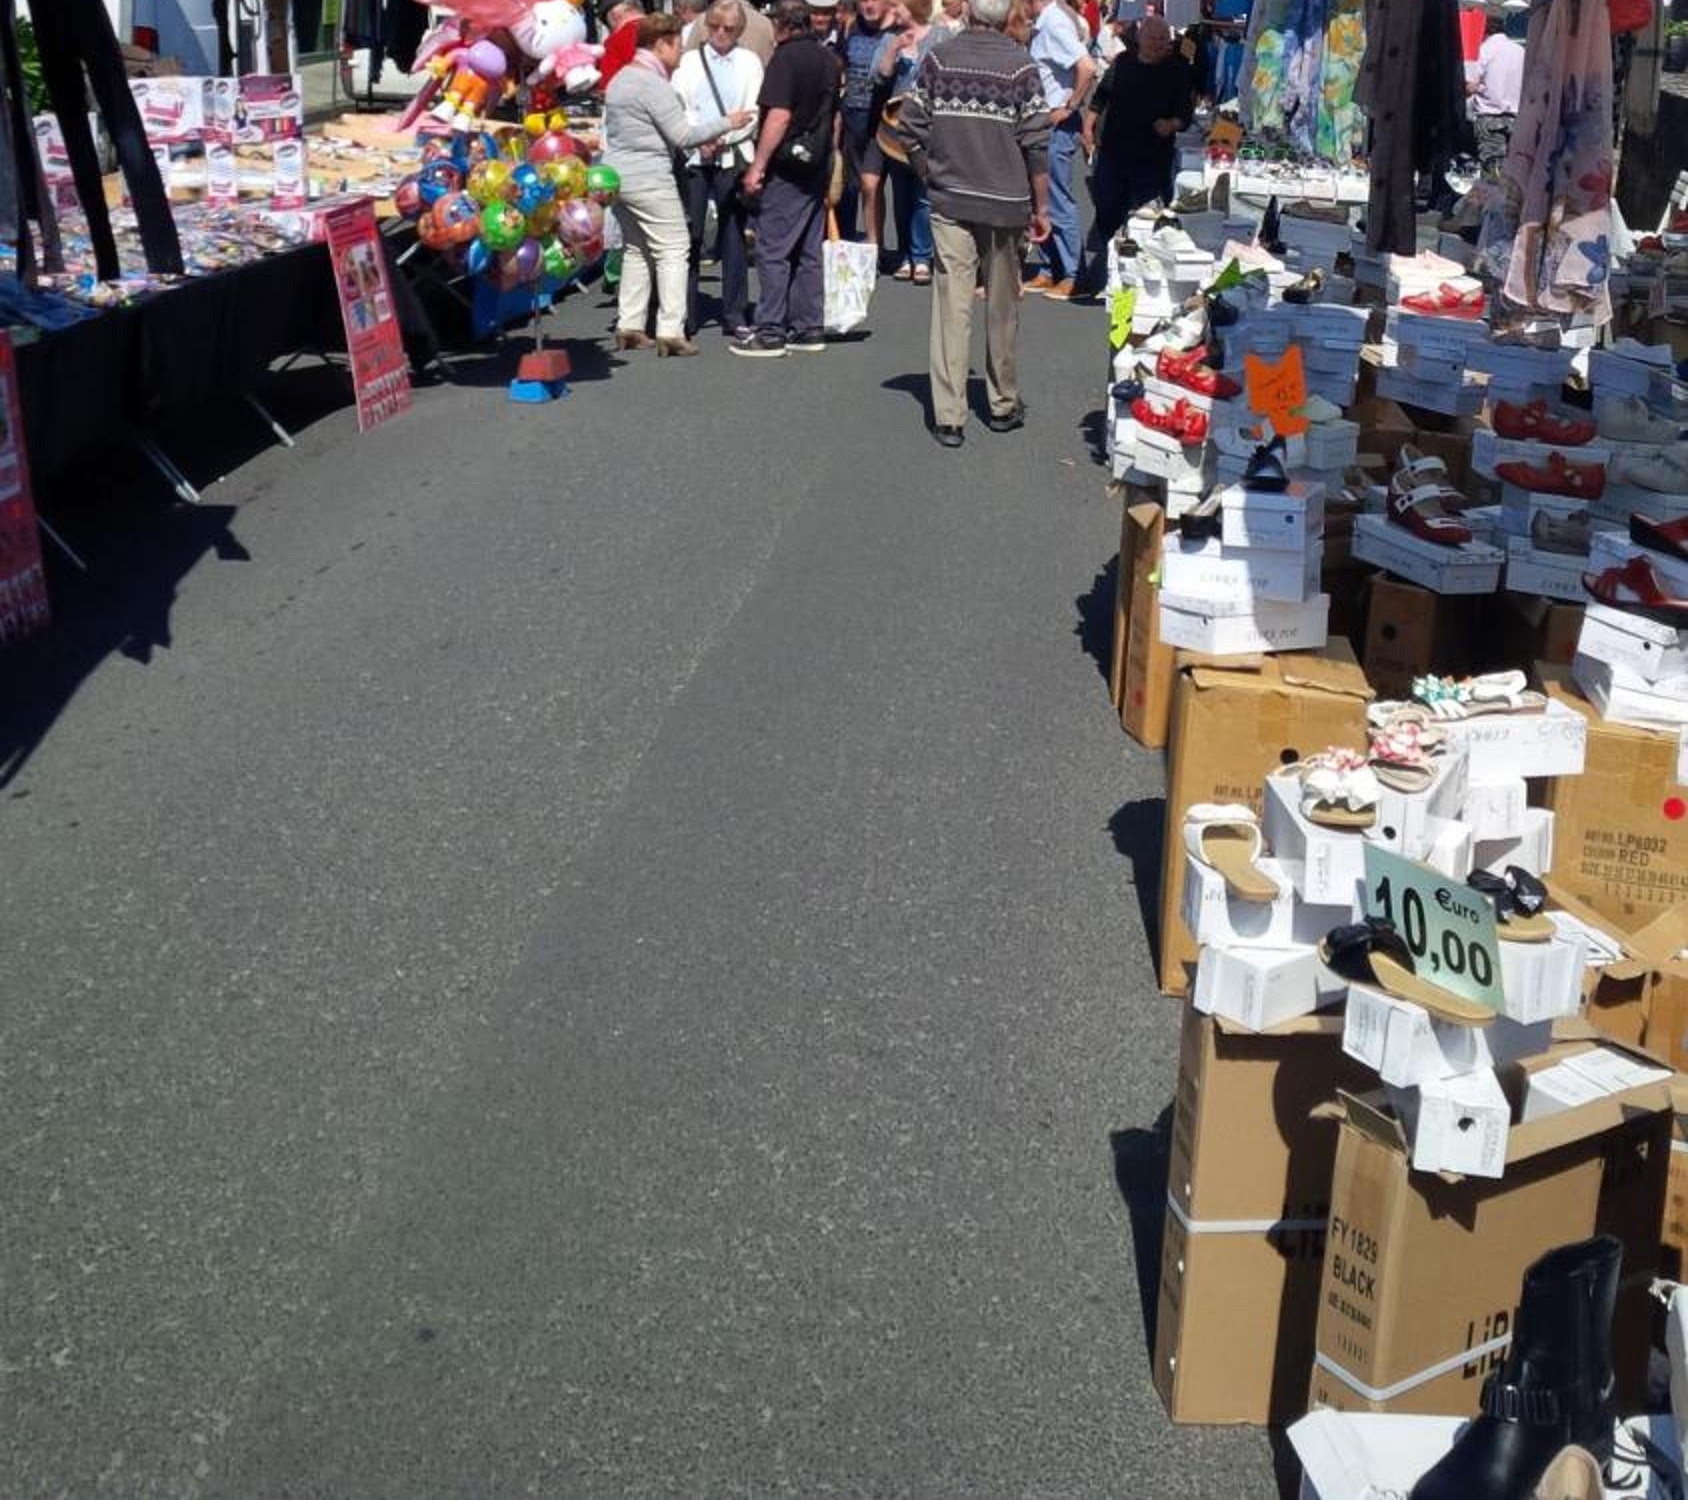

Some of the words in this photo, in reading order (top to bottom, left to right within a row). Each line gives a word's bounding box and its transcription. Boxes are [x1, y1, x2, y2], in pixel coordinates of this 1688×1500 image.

[1618, 849, 1650, 867] RED
[1375, 875, 1493, 988] 10,00
[1332, 1253, 1377, 1302] BLACK
